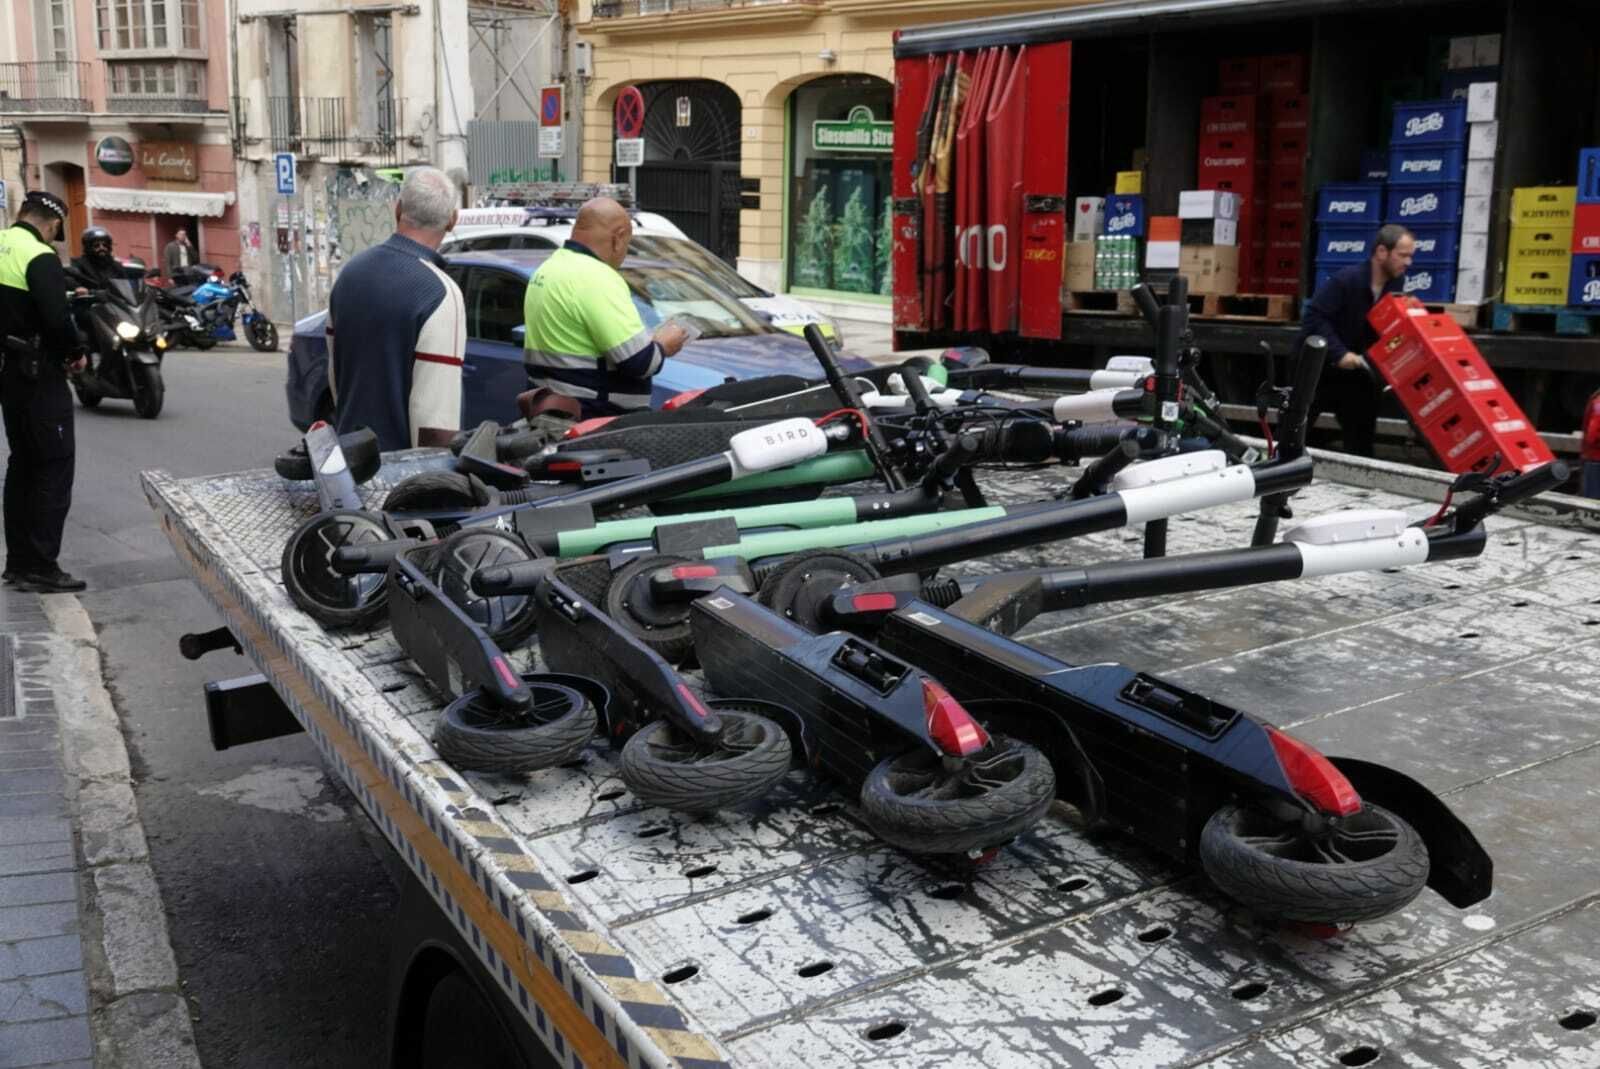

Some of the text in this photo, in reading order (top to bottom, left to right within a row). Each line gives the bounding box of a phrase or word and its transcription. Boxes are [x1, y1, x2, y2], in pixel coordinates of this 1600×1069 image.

[818, 128, 870, 145] Sinsemilla
[1401, 160, 1442, 172] PEPSI
[1328, 201, 1367, 213] PEPSI
[1521, 210, 1570, 218] SCHWEPPES
[1327, 241, 1366, 253] PEPSI
[1414, 240, 1436, 251] PSI
[1518, 249, 1567, 257] SCHWEPPES
[1514, 287, 1563, 296] SCHWEPPES
[765, 428, 808, 446] BIRD
